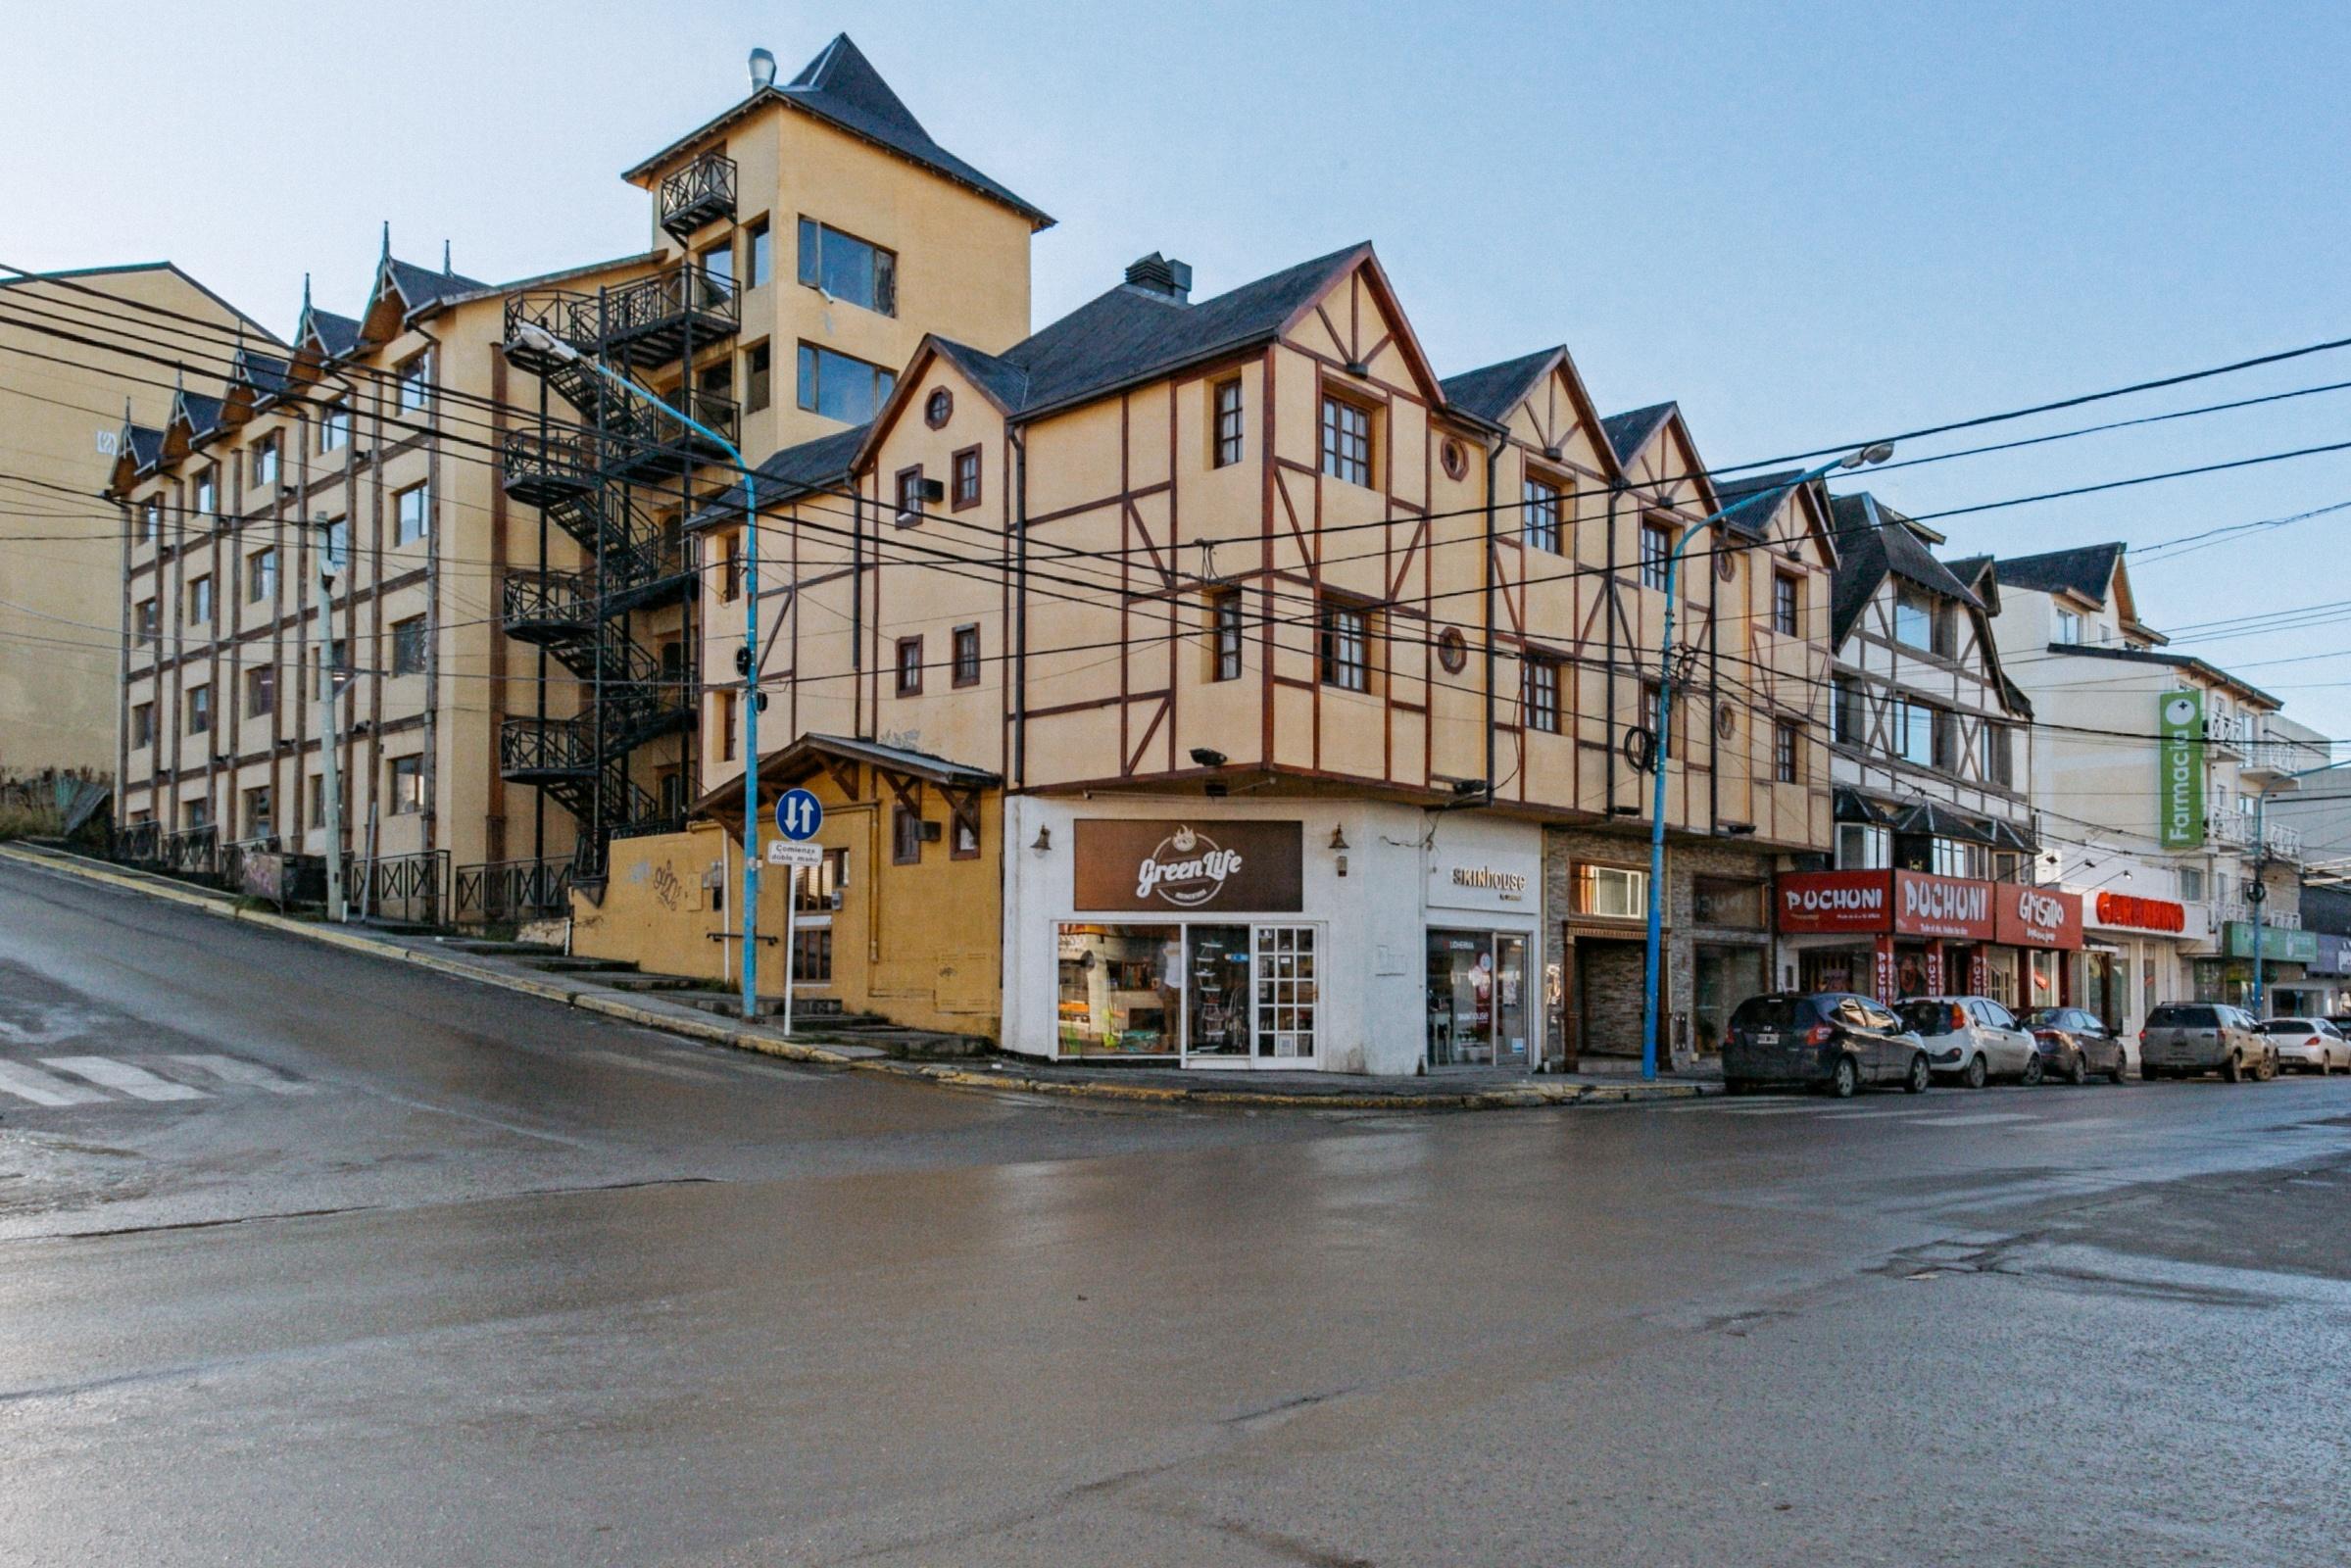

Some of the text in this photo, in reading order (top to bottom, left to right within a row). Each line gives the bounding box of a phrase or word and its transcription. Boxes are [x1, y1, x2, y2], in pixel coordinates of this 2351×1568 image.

[2169, 729, 2190, 841] Farmacia
[1786, 888, 1883, 910] PUCHUNI
[1904, 879, 1986, 921] PUCHUNI
